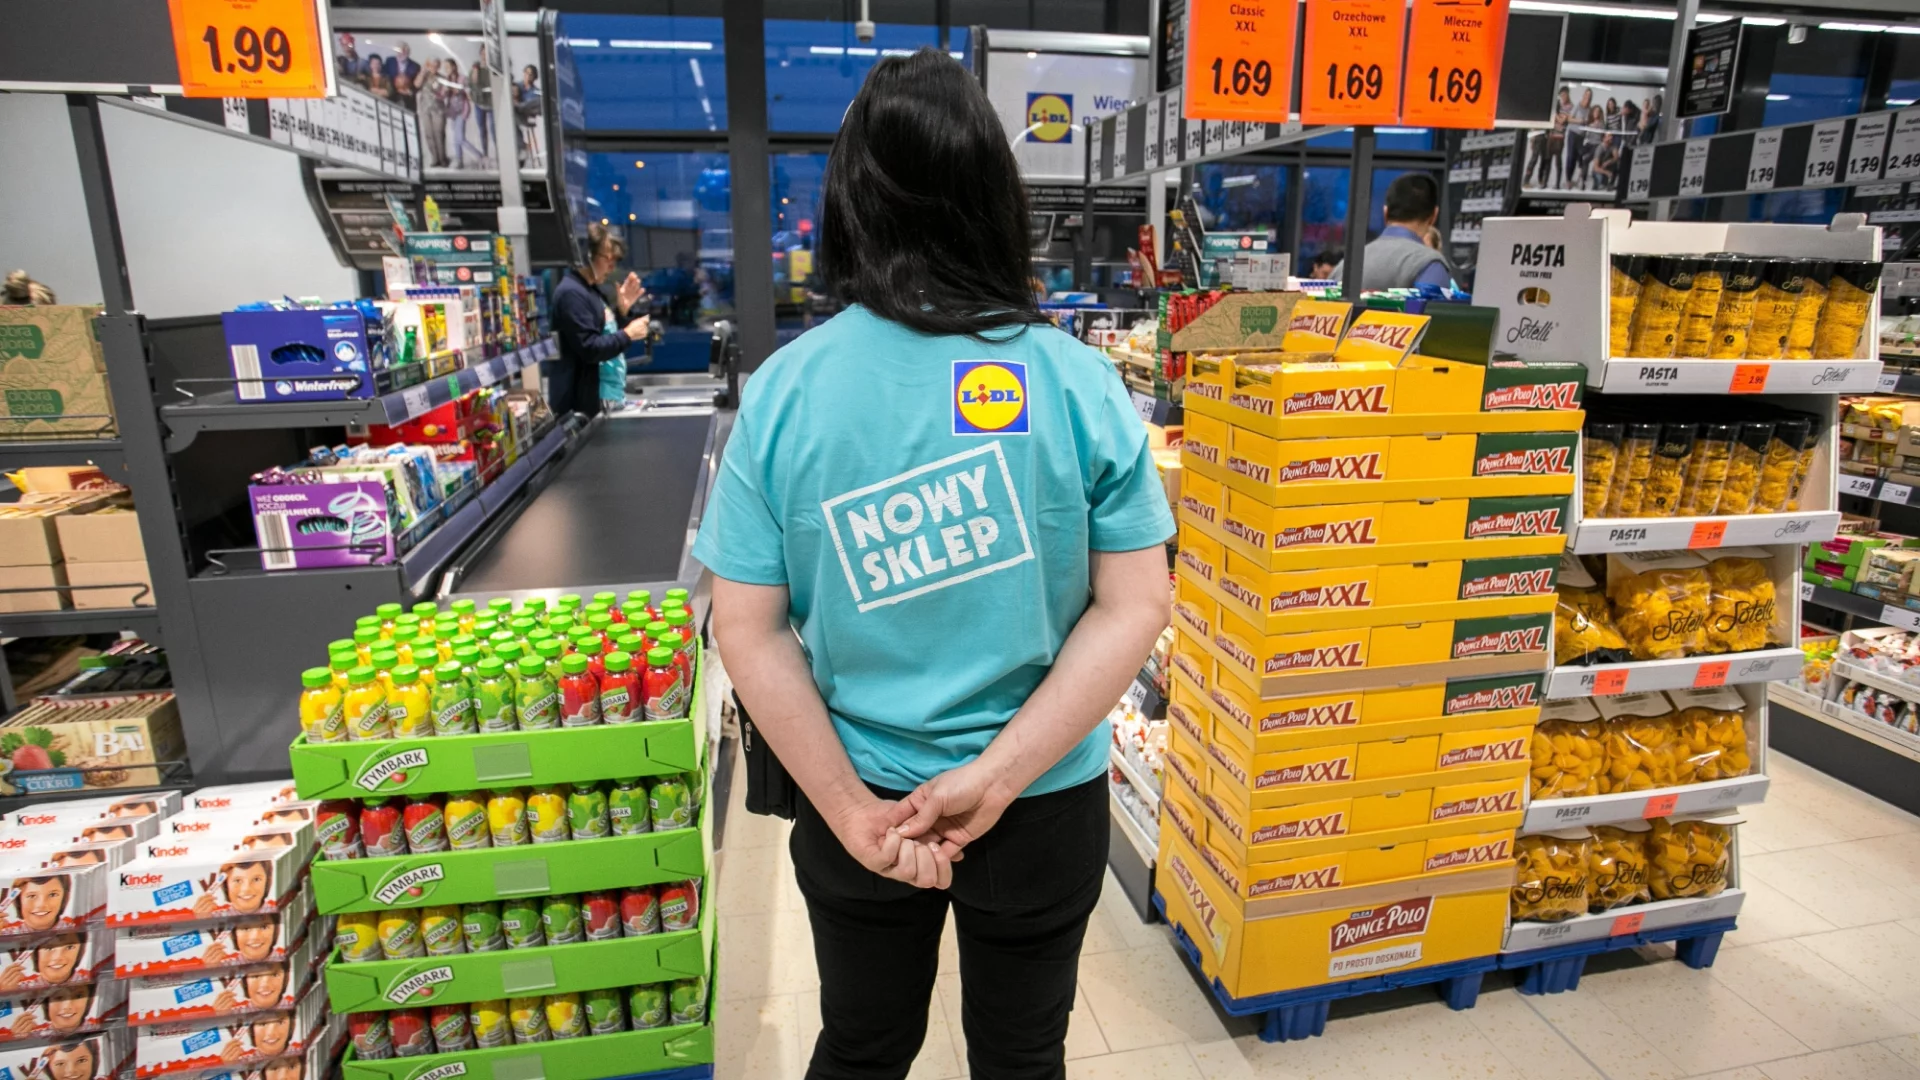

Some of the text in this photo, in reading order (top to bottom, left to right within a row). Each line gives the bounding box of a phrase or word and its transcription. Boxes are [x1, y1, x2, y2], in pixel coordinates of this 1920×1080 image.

[1230, 4, 1265, 17] Classic
[1332, 10, 1386, 23] Orzechowe
[1443, 15, 1482, 28] Mleczne
[1235, 20, 1257, 32] XXL
[1349, 26, 1368, 37] XXL
[1451, 32, 1471, 42] XXL
[202, 25, 292, 74] 1.99
[1211, 57, 1272, 97] 1.69
[1327, 63, 1383, 100] 1.69
[1428, 66, 1482, 104] 1.69
[1808, 160, 1835, 178] 1.79
[1850, 156, 1880, 174] 1.79
[1888, 153, 1920, 170] 2.49
[1630, 179, 1649, 193] 1.79
[1681, 175, 1703, 189] 2.49
[1750, 167, 1774, 184] 1.79
[414, 238, 452, 250] ASPIRIN
[1211, 238, 1240, 249] ASPIRIN
[1510, 243, 1565, 268] PASTA
[1539, 271, 1552, 280] FREE
[1241, 305, 1271, 316] dobra
[1313, 316, 1339, 338] XXL
[1378, 327, 1406, 350] XXL
[1639, 366, 1678, 381] PASTA
[1749, 375, 1764, 385] 2.99
[1286, 386, 1389, 413] PRINCE POLO XXL
[1487, 382, 1580, 410] PRINCE POLO XXL
[1281, 454, 1383, 481] PRINCE POLO XXL
[1478, 447, 1572, 474] PRINCE POLO XXL
[1850, 480, 1871, 492] 2.99
[847, 464, 989, 549] NOWY
[1276, 519, 1376, 547] PRINCE POLO XXL
[1471, 509, 1562, 534] PRINCE POLO XXL
[1609, 527, 1647, 541] PASTA
[862, 515, 1000, 592] SKLEP
[1464, 568, 1555, 594] PRINCE POLO XXL
[1272, 582, 1371, 611] PRINCE POLO XXL
[1456, 627, 1546, 655] PRINCE POLO XXL
[1266, 643, 1364, 672] PRINCE POLO XXL
[525, 693, 557, 721] TYMBARK
[1449, 682, 1538, 711] PRINCE POLO XXL
[438, 699, 470, 725] TYMBARK
[1261, 702, 1357, 732] PRINCE POLO XXL
[93, 731, 145, 757] BA!
[1442, 738, 1525, 766] PRINCE POLO XXL
[362, 749, 425, 787] TYMBARK
[1256, 758, 1351, 788] PRINCE POLO XXL
[26, 779, 75, 791] CUKRU
[1434, 790, 1518, 820] PRINCE POLO XXL
[1555, 805, 1591, 819] PASTA
[412, 815, 443, 843] TYMBARK
[452, 812, 484, 840] TYMBARK
[1252, 813, 1346, 843] PRINCE POLO XXL
[0, 838, 26, 849] nder
[1427, 840, 1509, 870] PRINCE POLO XXL
[381, 866, 440, 901] TYMBARK
[1250, 867, 1341, 897] PRINCE POLO XXL
[1524, 875, 1587, 904] Sotelli
[1334, 904, 1425, 947] PRINCE POLO
[1537, 925, 1571, 937] PASTA
[1333, 948, 1417, 971] PO PROSTU DOSKONAŁE
[391, 968, 449, 1003] TYMBARK
